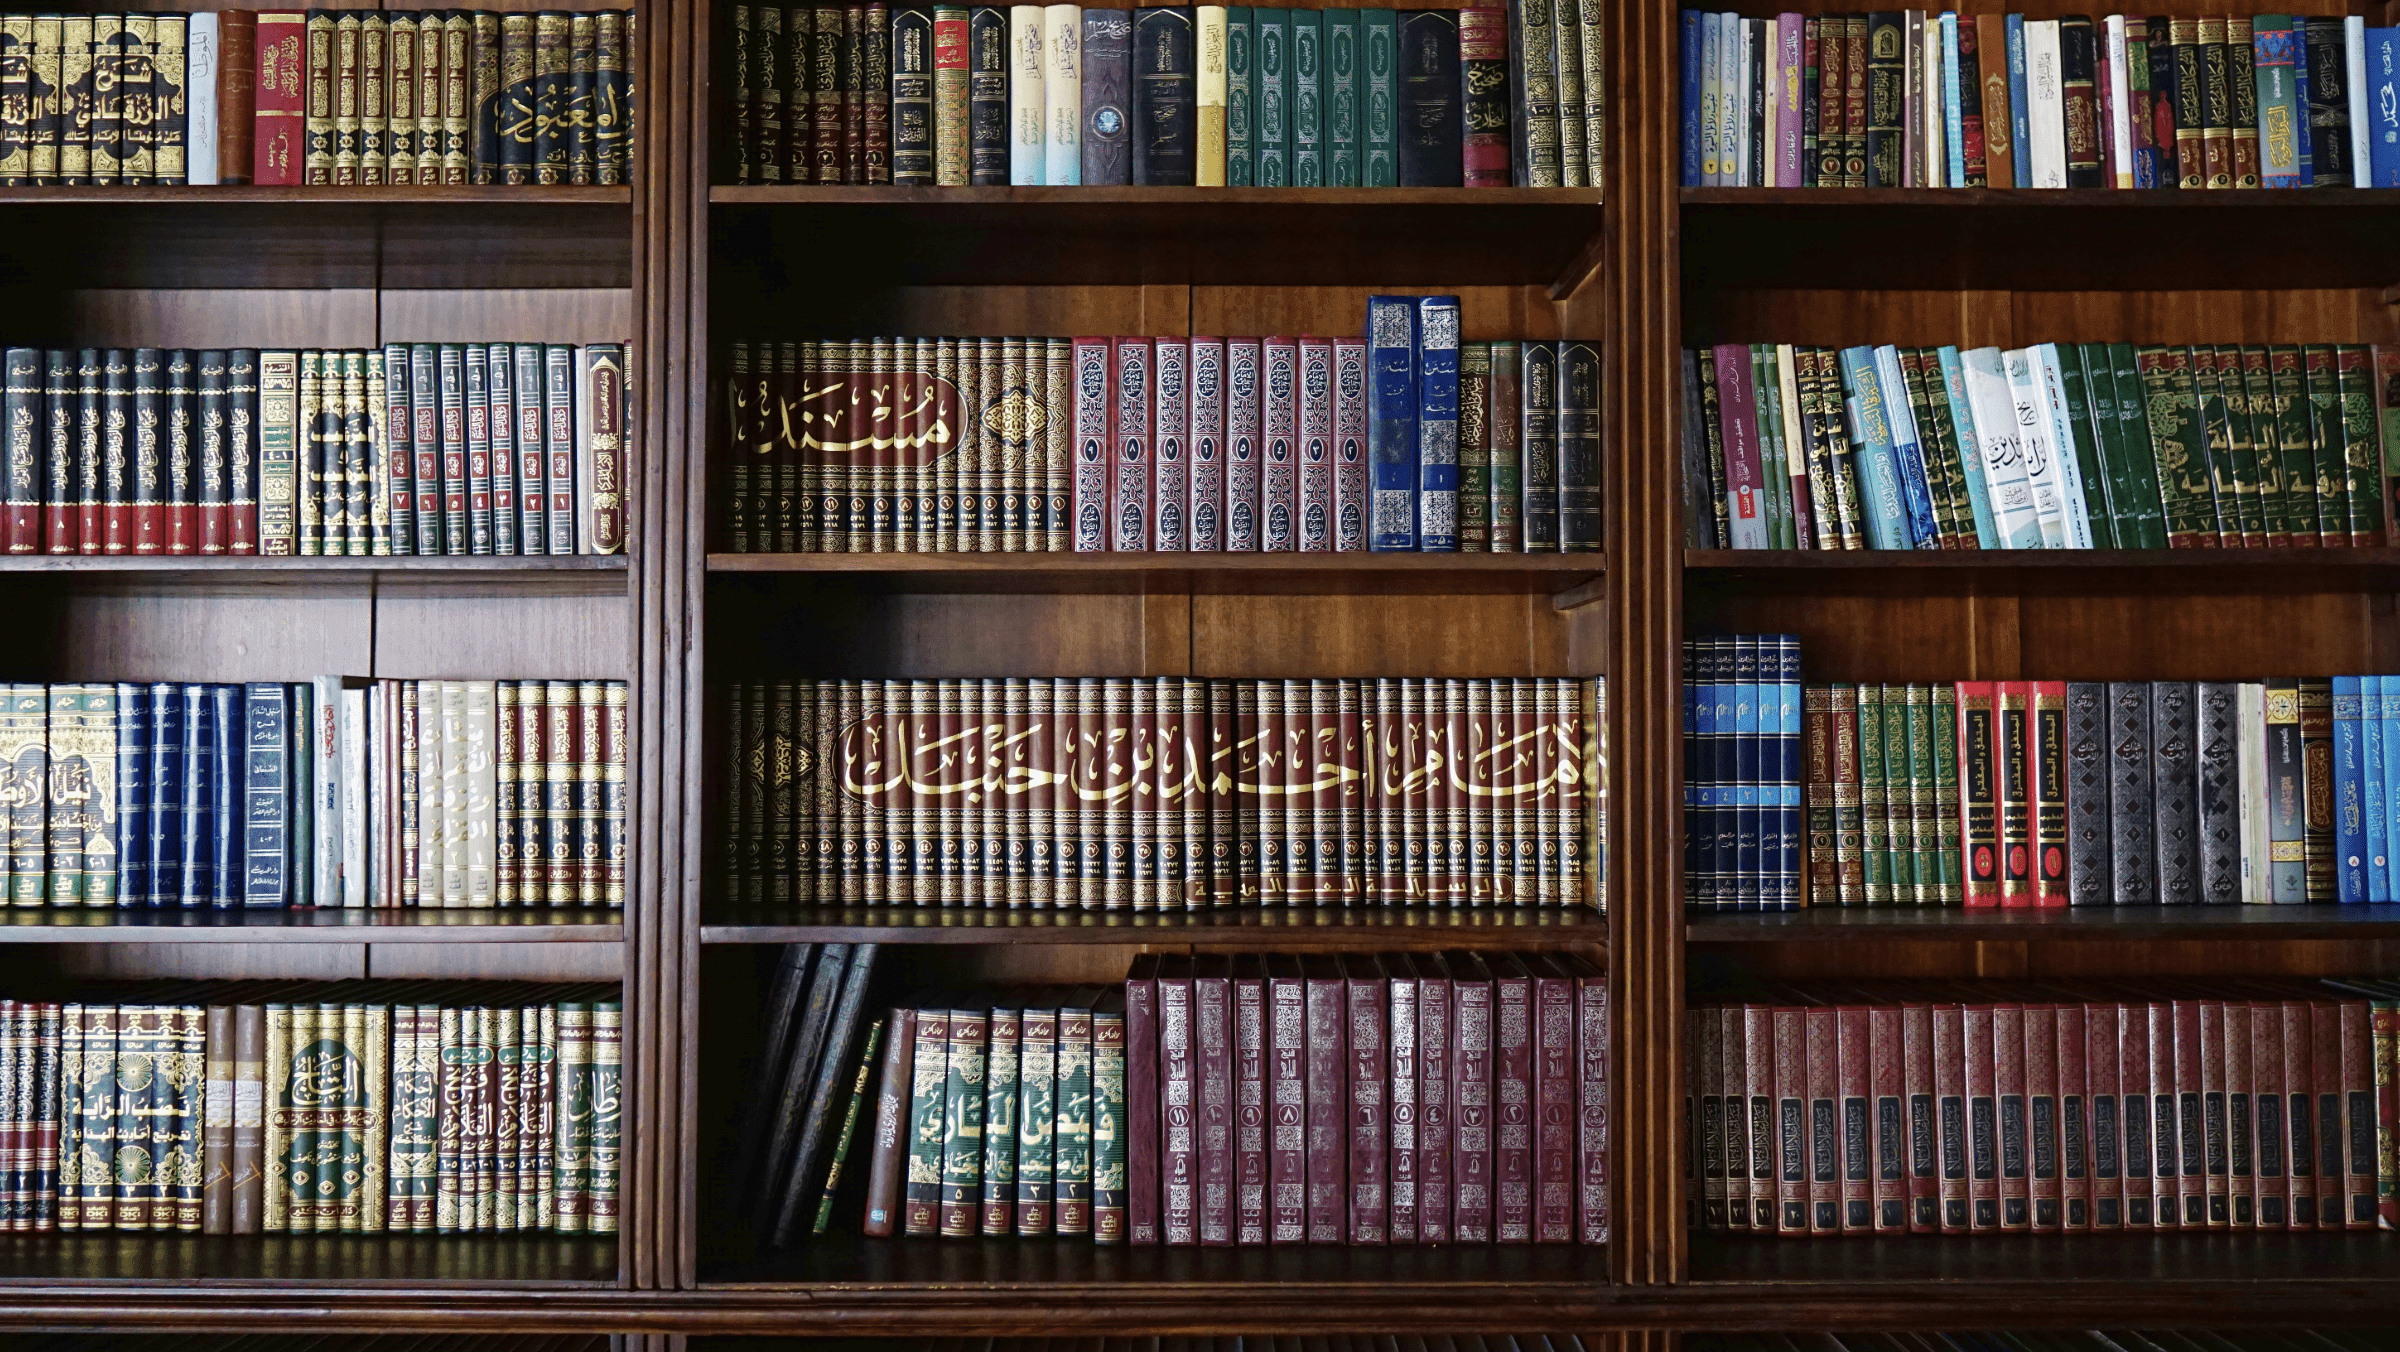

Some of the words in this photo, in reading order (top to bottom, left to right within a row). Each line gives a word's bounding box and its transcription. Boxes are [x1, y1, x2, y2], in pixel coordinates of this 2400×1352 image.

[1467, 62, 1504, 94] صحيح
[2267, 105, 2291, 135] السيرة
[2380, 81, 2398, 127] محمد
[2269, 134, 2292, 167] النبوية
[1864, 404, 1888, 445] النبوية
